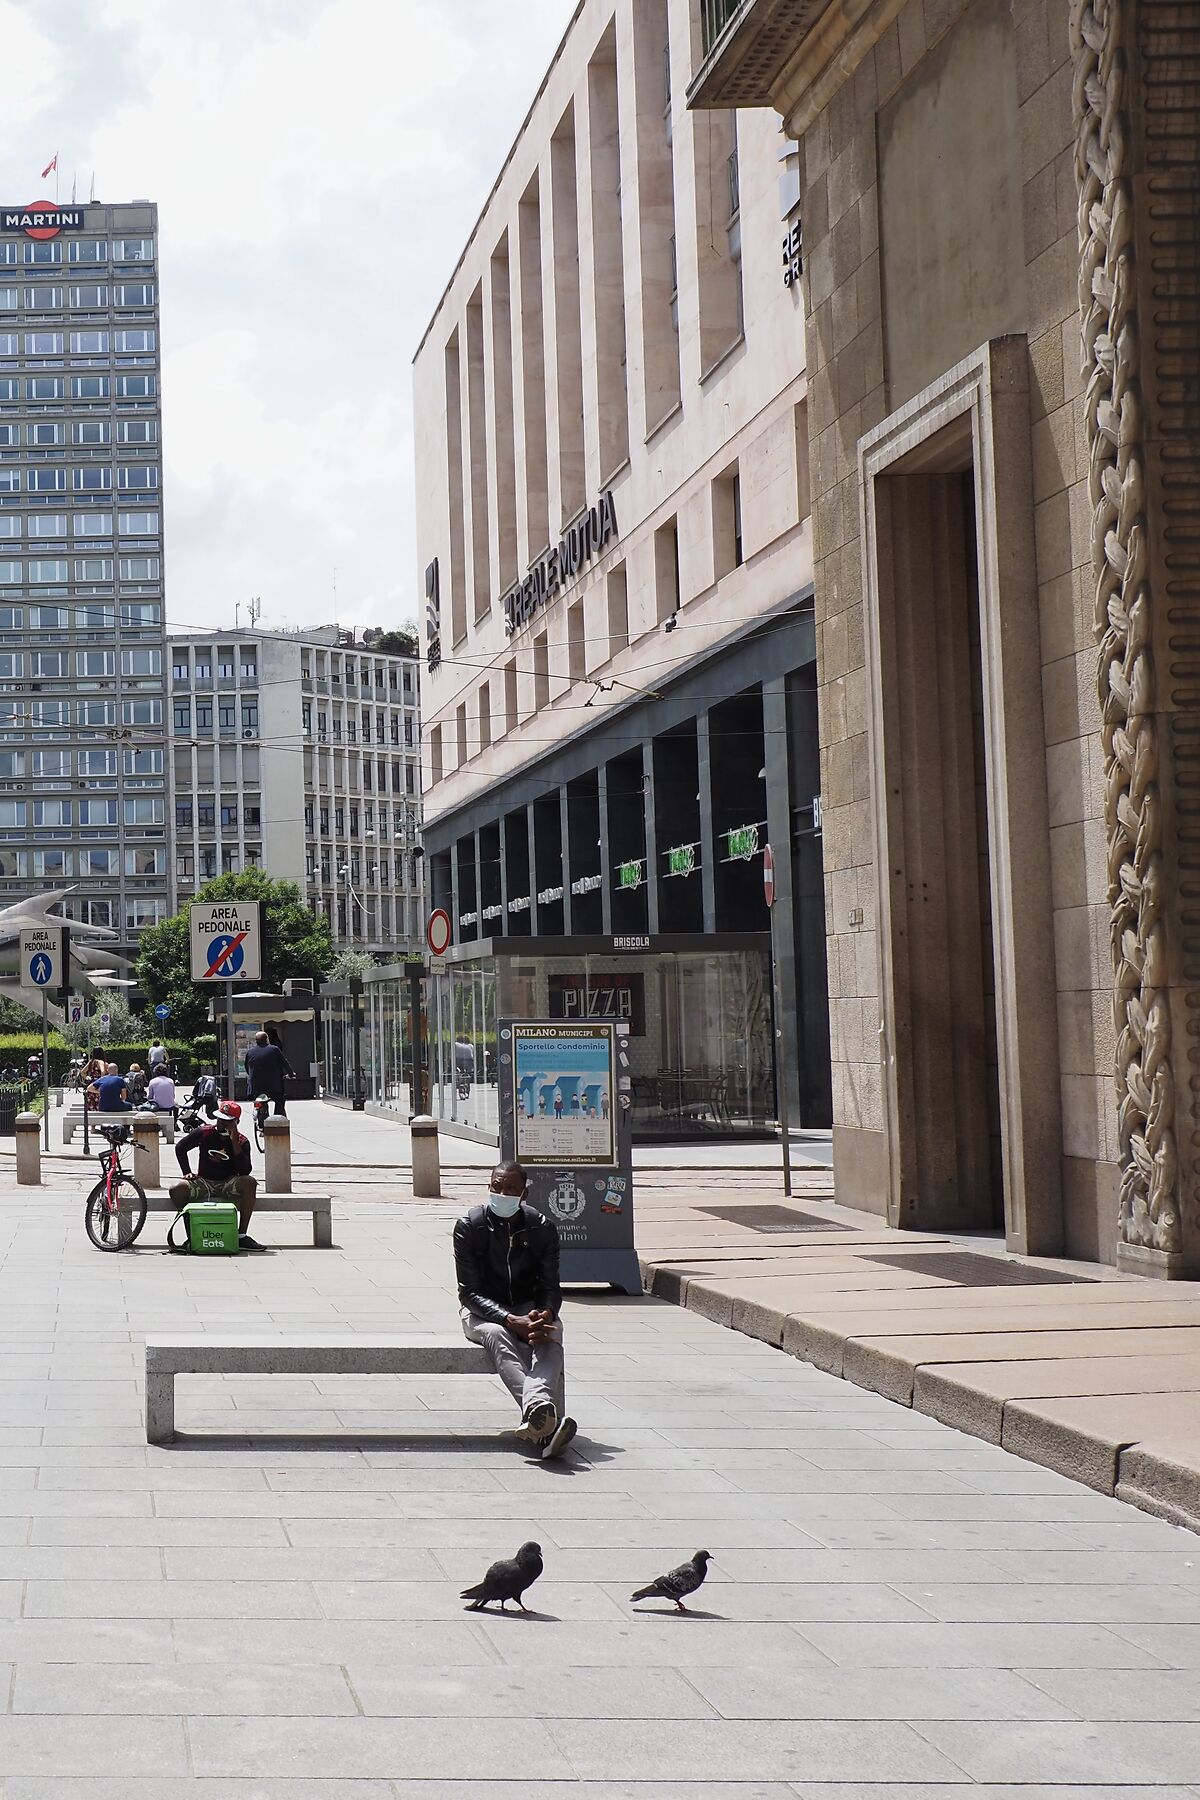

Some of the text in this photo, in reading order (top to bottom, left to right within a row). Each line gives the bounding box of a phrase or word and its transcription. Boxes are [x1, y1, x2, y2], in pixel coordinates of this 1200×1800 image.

[6, 213, 79, 226] MARTINI
[512, 490, 618, 628] REALE MUTUA
[211, 908, 238, 919] AREA
[198, 920, 251, 933] PEDONALE
[32, 931, 49, 940] AREA
[24, 942, 57, 951] PEDONALE
[613, 937, 650, 947] BRISCOLA
[563, 988, 632, 1018] PIZZA
[516, 1028, 557, 1037] MILANO
[518, 1042, 606, 1051] Sportello Condominio
[202, 1230, 224, 1239] Uber
[202, 1239, 225, 1248] Eats
